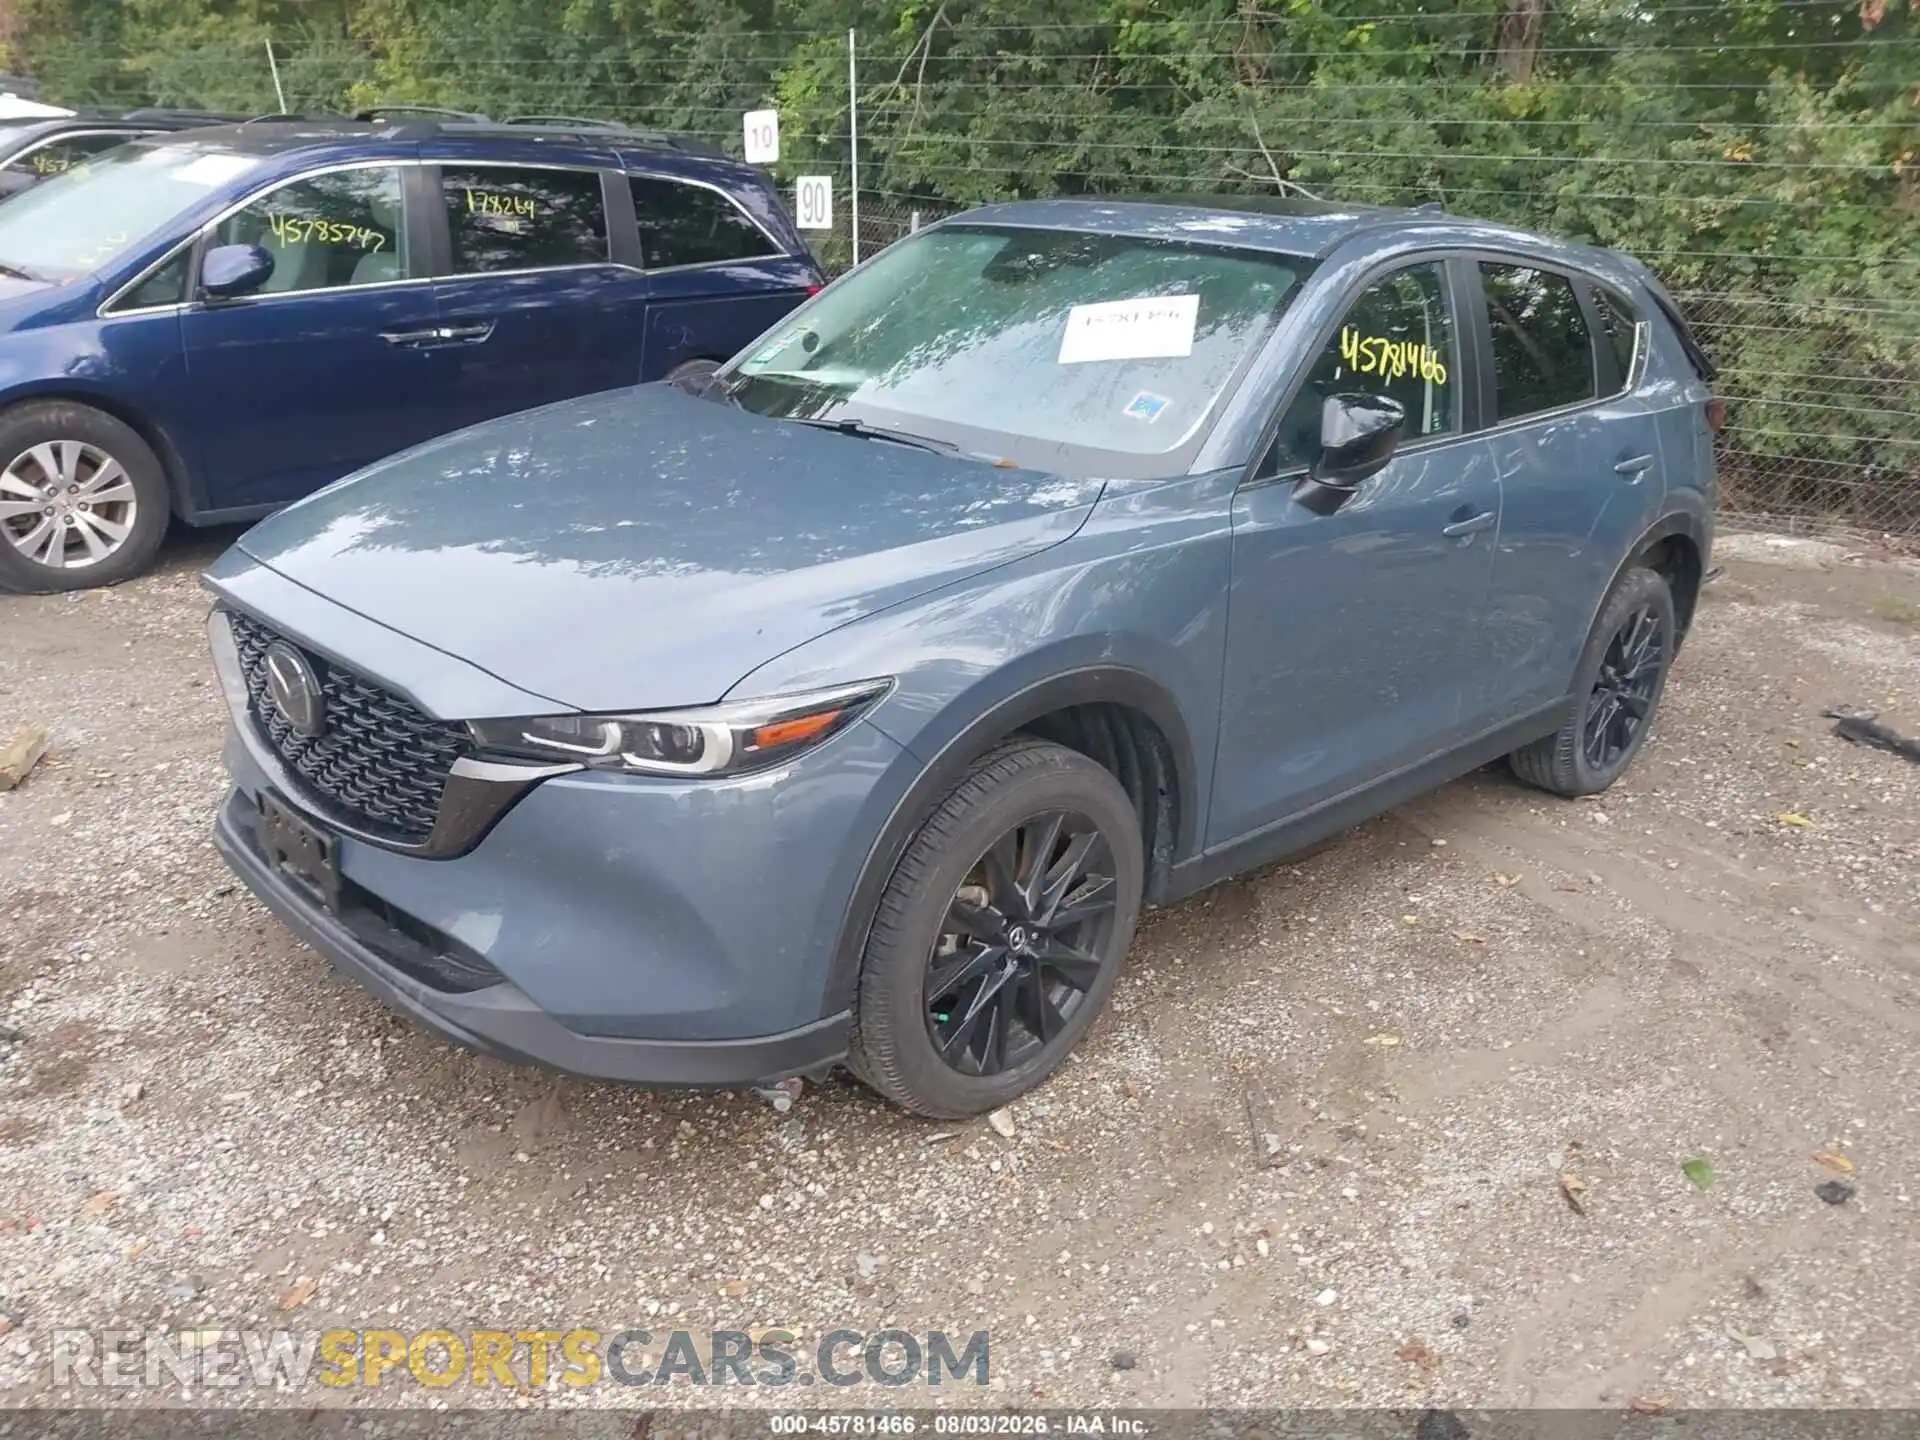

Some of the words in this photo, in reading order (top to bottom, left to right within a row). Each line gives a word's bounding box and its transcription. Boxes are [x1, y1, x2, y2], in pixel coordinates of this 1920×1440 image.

[752, 126, 772, 148] 10
[466, 187, 534, 220] 178264
[802, 182, 825, 222] 90
[269, 213, 385, 253] 45785747
[1341, 325, 1447, 385] 45781466
